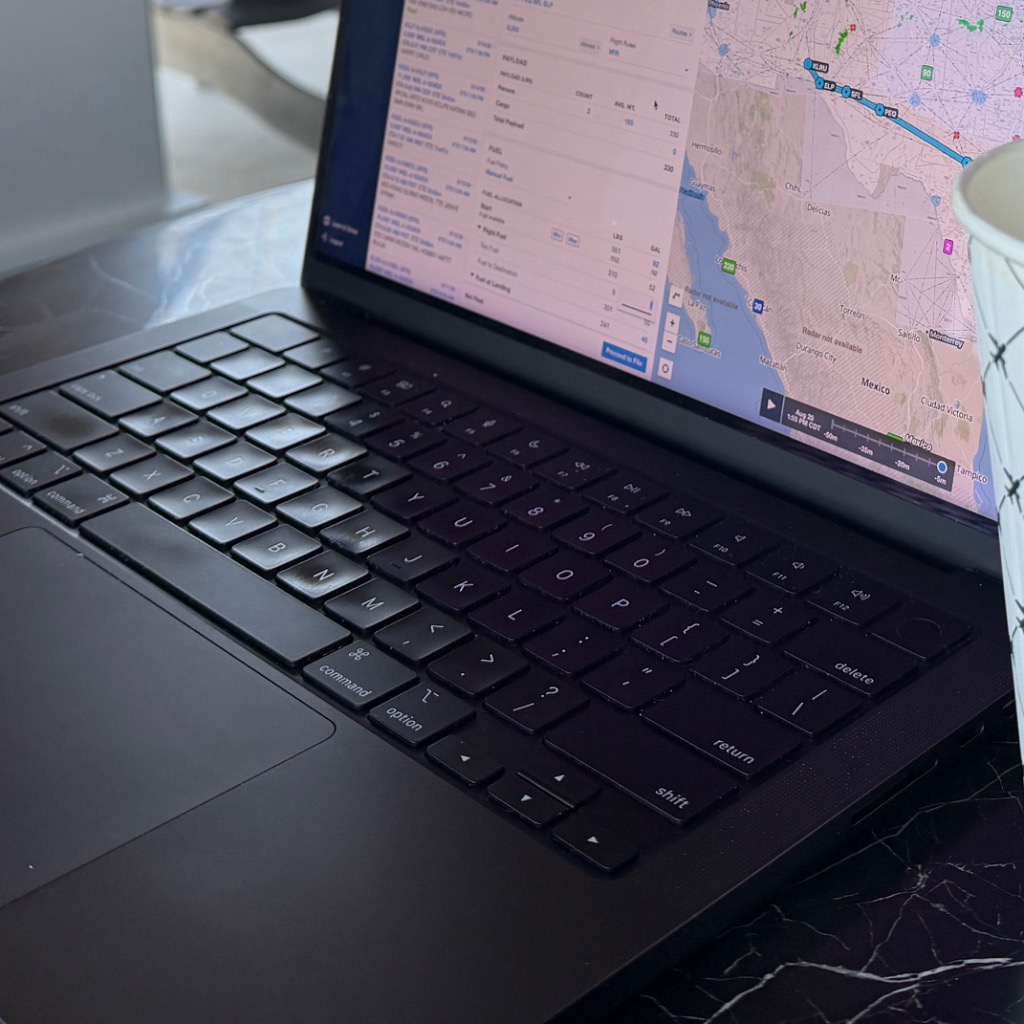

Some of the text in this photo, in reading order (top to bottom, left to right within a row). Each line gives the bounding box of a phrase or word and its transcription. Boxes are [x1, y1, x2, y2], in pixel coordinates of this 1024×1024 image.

[664, 113, 681, 124] TOTAL
[691, 140, 722, 155] Hermosillo
[806, 202, 831, 217] Delicias
[839, 304, 865, 320] Torreón
[802, 326, 821, 339] Radar
[834, 337, 863, 354] available
[898, 328, 921, 343] Saltillo
[929, 329, 964, 349] Monterrey
[796, 341, 837, 364] Durango City
[861, 377, 891, 395] Mexico
[920, 396, 973, 423] Ciudad Victoria
[905, 433, 932, 451] Mexico
[957, 463, 988, 484] Tampico
[47, 489, 86, 516] command
[407, 491, 425, 504] Y
[453, 516, 473, 528] U
[355, 525, 376, 538] H
[267, 542, 286, 554] B
[712, 543, 729, 554] F10
[313, 568, 335, 582] N
[771, 570, 788, 582] F11
[453, 580, 474, 593] K
[361, 595, 385, 612] M
[611, 597, 630, 610] P
[833, 599, 850, 612] F12
[318, 663, 372, 699] command
[833, 661, 875, 686] delete
[385, 705, 424, 733] option
[713, 738, 756, 765] return
[655, 785, 691, 810] shift
